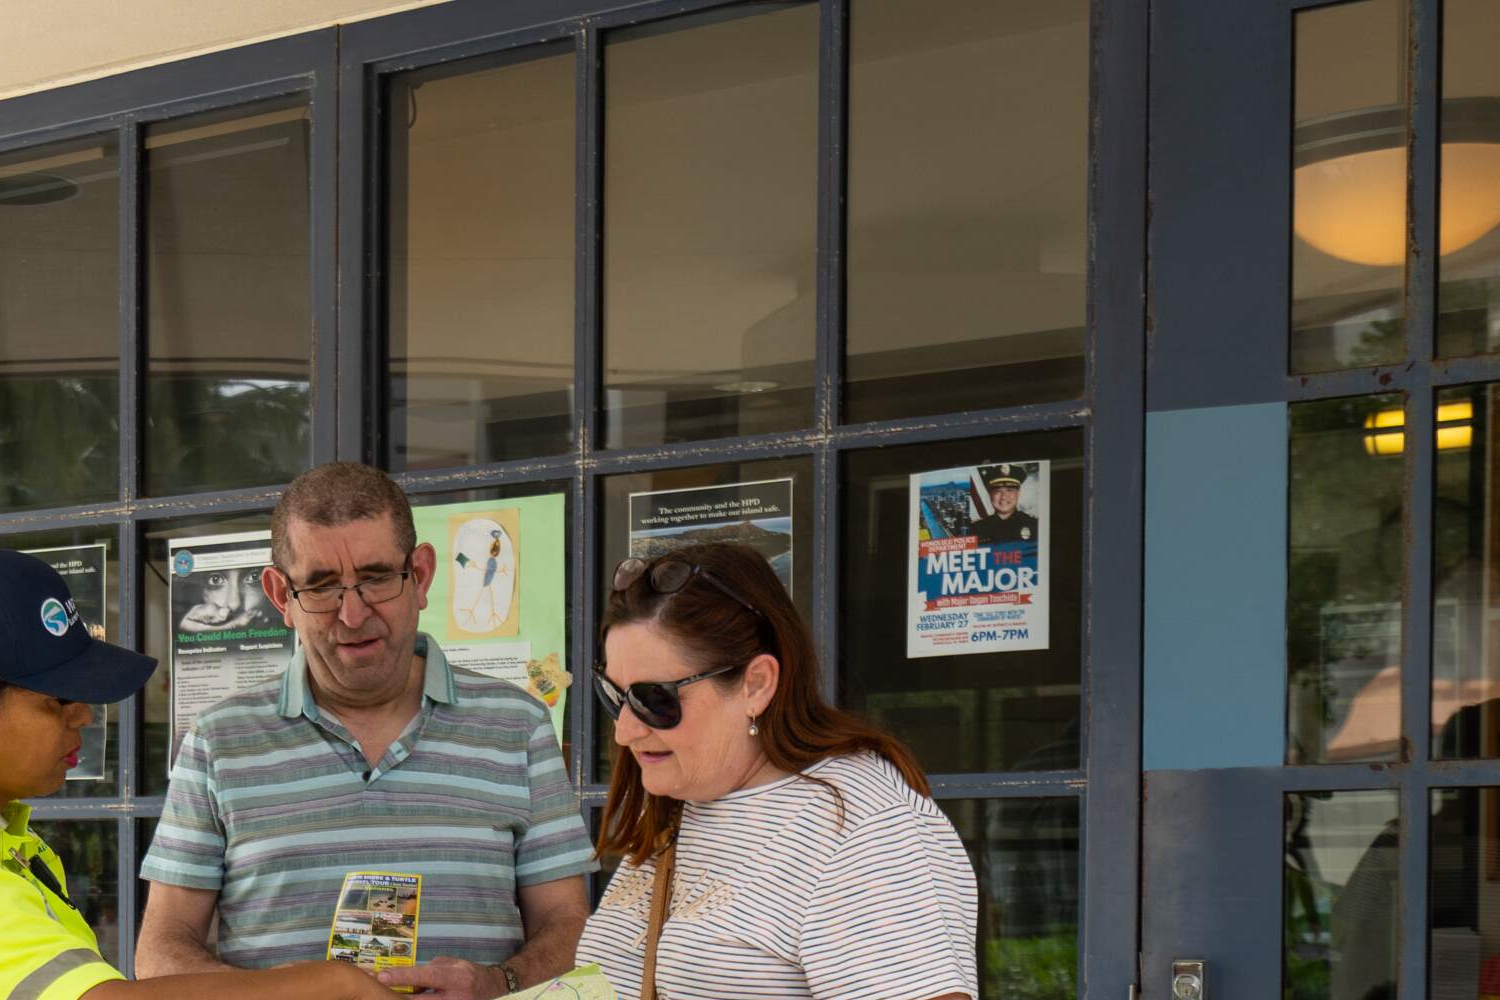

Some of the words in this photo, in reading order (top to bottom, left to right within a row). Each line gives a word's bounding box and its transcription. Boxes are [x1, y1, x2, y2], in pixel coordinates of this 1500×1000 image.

[658, 506, 673, 515] The
[673, 503, 713, 515] community
[714, 501, 728, 510] and
[728, 500, 740, 509] the
[741, 498, 761, 508] HPD
[640, 515, 670, 525] working
[670, 512, 700, 523] together
[708, 510, 728, 519] make
[741, 507, 763, 515] island
[764, 504, 781, 513] safe.
[920, 539, 953, 548] HONOLULU
[953, 536, 977, 545] POLICE
[928, 544, 967, 553] DEPARTMENT
[68, 560, 83, 568] HPD
[926, 547, 991, 575] MEET
[993, 550, 1022, 565] THE
[941, 567, 1037, 595] MAJOR
[936, 597, 952, 608] with
[919, 612, 970, 623] WEDNESDAY
[916, 621, 956, 632] FEBRUARY
[958, 620, 969, 629] 27
[178, 634, 195, 643] You
[196, 632, 221, 642] Could
[222, 631, 247, 641] Mean
[248, 628, 288, 640] Freedom
[971, 628, 1030, 642] 6PM-7PM
